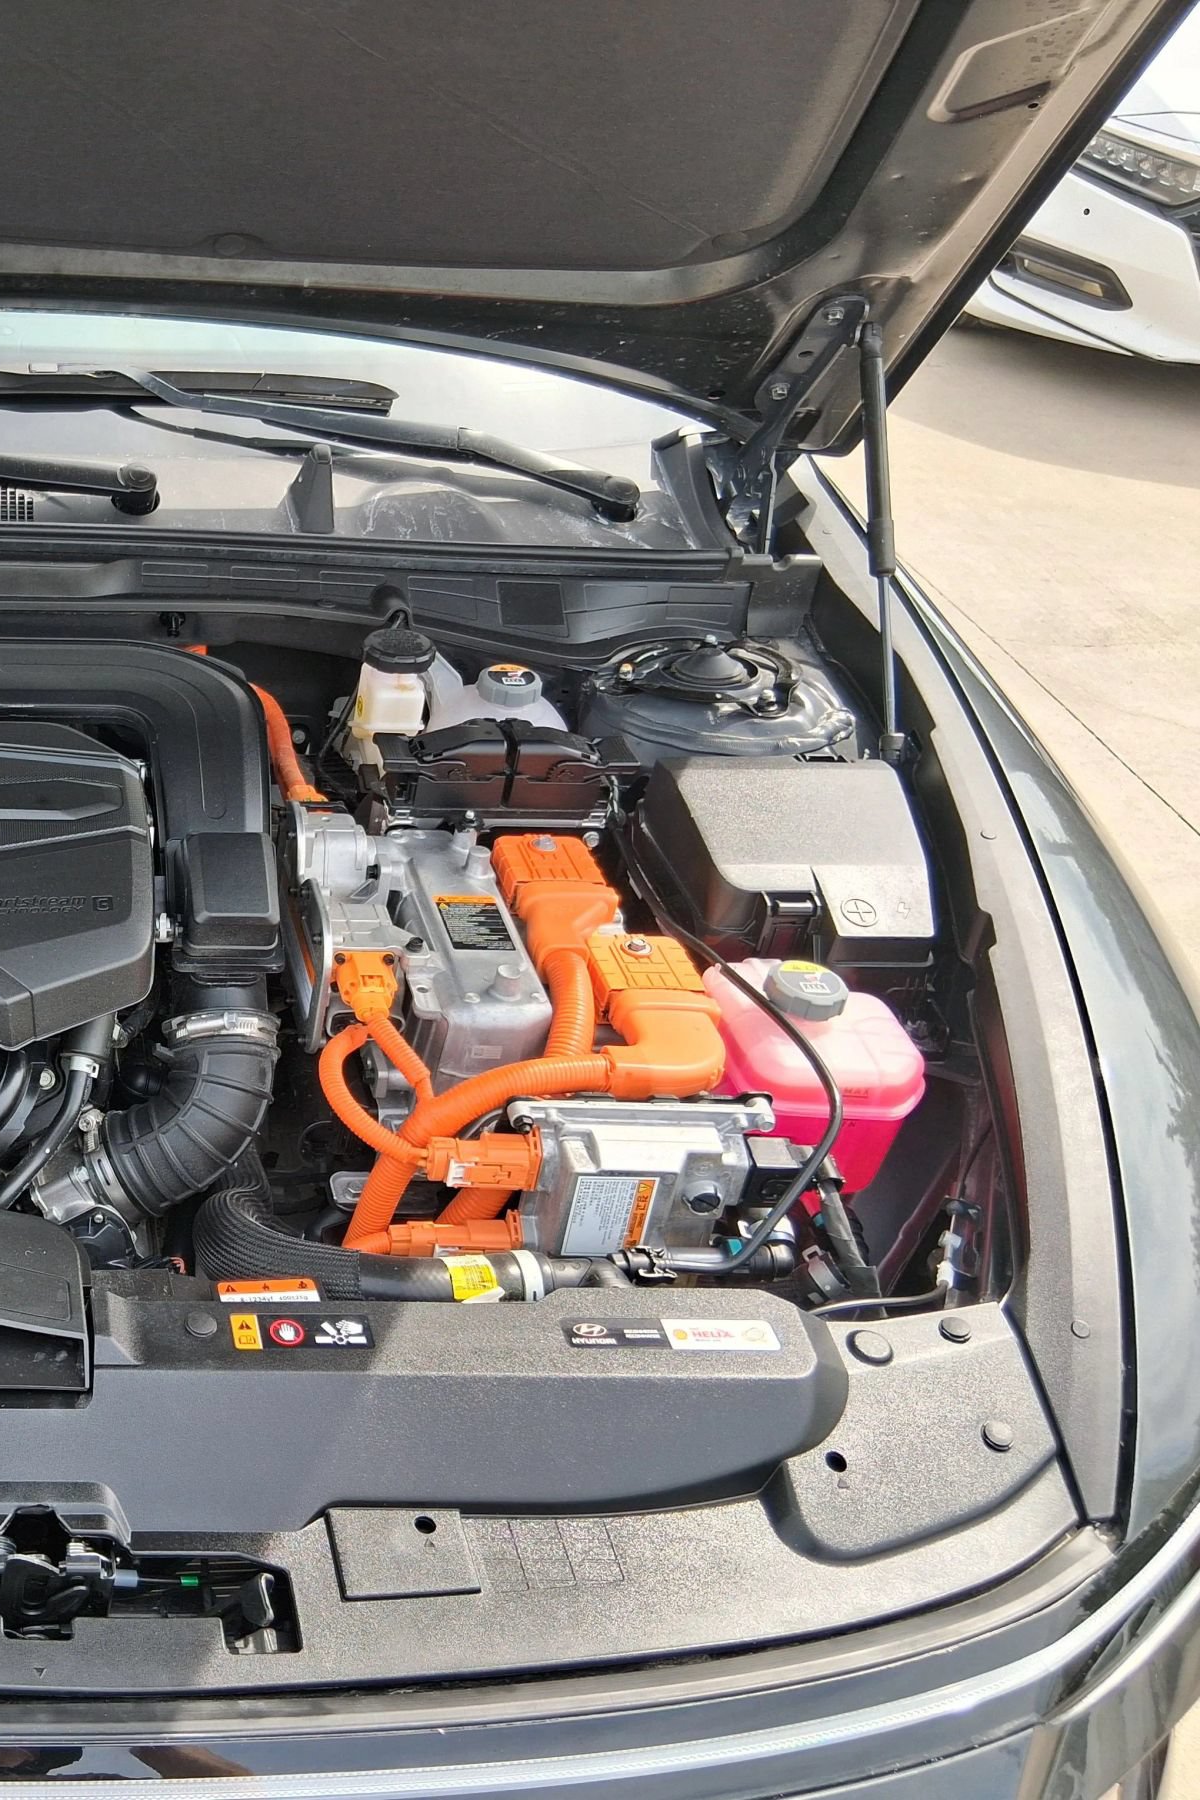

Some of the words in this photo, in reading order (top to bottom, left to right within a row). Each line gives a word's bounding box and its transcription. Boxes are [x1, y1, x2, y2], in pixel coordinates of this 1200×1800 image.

[844, 1087, 870, 1095] MAX
[691, 1328, 736, 1339] HELIX
[571, 1336, 618, 1346] HYUNDAI
